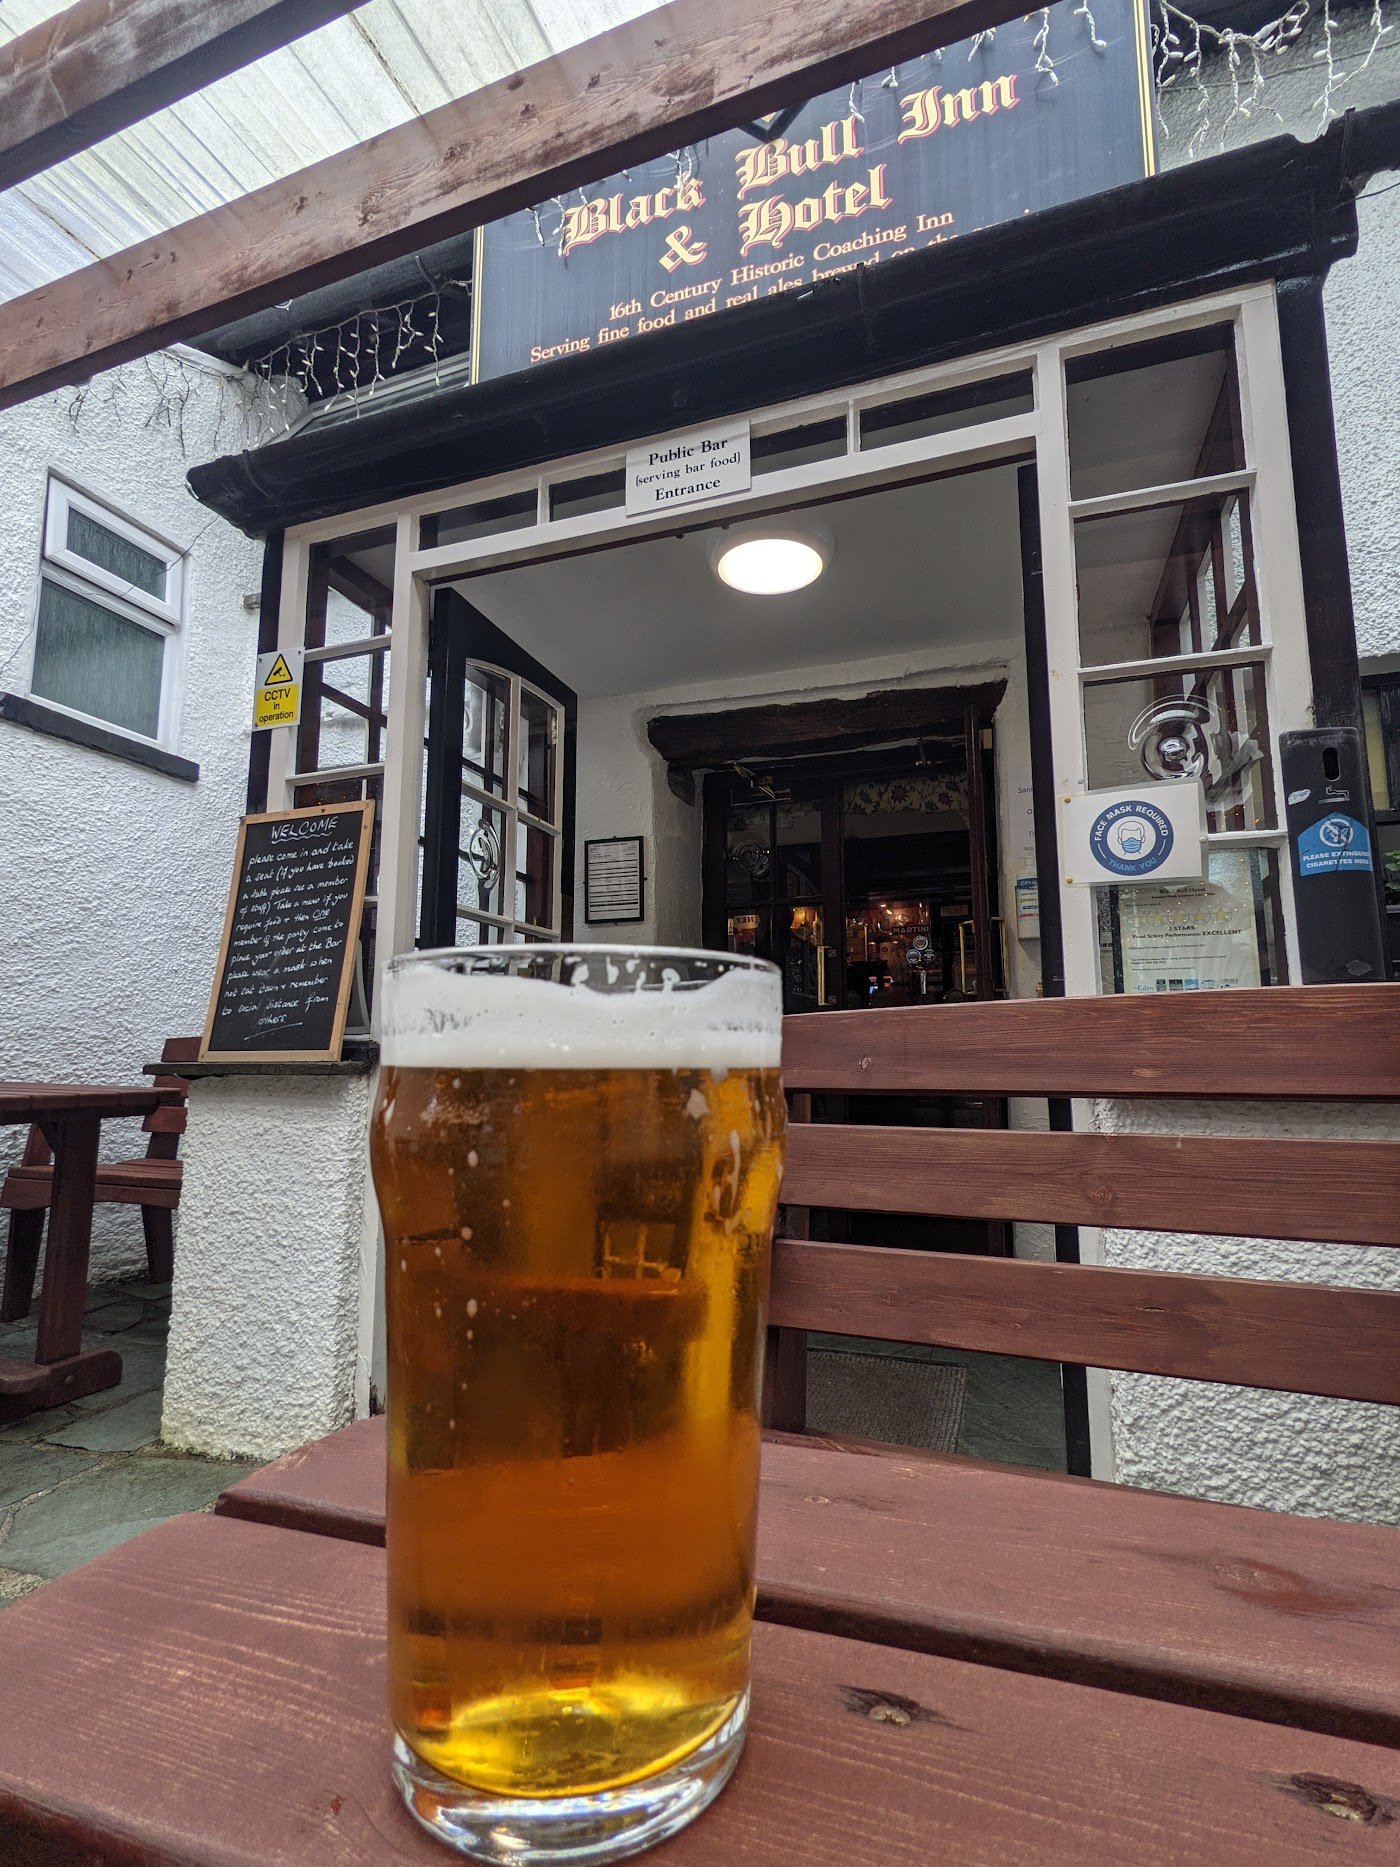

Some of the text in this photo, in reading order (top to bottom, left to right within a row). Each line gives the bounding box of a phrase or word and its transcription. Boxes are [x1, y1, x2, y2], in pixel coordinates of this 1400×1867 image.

[562, 74, 1020, 257] Black Bull Inn
[659, 163, 893, 274] & Hotel
[609, 299, 642, 321] 16th
[650, 278, 722, 308] Century
[730, 253, 805, 286] Historic
[813, 224, 907, 261] Coaching
[916, 211, 955, 233] Inn
[530, 337, 590, 362] Serving
[597, 324, 630, 344] fine
[637, 309, 677, 333] food
[684, 297, 717, 320] and
[725, 285, 758, 308] real
[767, 278, 803, 296] ales
[649, 440, 728, 466] Public Bar
[635, 451, 741, 487] (serving bar food)
[654, 479, 721, 501] Entrance
[264, 688, 291, 702] CCTV
[273, 702, 280, 710] in
[259, 711, 294, 724] operation
[271, 816, 338, 839] WELCOME
[1095, 805, 1169, 841] FACE MASK REQUIRED
[247, 838, 354, 870] please come in and take
[1108, 857, 1157, 872] THANK YOU
[1303, 852, 1330, 861] PLEASE
[1306, 859, 1353, 869] CIGARETTES
[255, 869, 274, 881] seat
[288, 867, 304, 879] you
[306, 862, 324, 872] have
[328, 855, 354, 868] booked
[251, 888, 268, 899] table
[270, 887, 291, 900] please
[317, 875, 348, 888] member
[233, 934, 262, 947] member
[273, 932, 284, 941] the
[285, 928, 310, 945] party
[313, 924, 332, 933] come
[334, 919, 344, 929] to
[236, 921, 261, 935] require
[264, 916, 281, 932] food
[893, 925, 929, 934] MARTINI
[230, 953, 251, 967] place
[274, 945, 295, 957] order
[296, 944, 307, 953] at
[308, 940, 322, 951] the
[226, 970, 249, 985] please
[283, 959, 305, 973] mask
[310, 955, 333, 967] when
[224, 988, 238, 998] not
[259, 982, 278, 994] down
[290, 974, 329, 989] remember
[222, 992, 329, 1016] to social distance from
